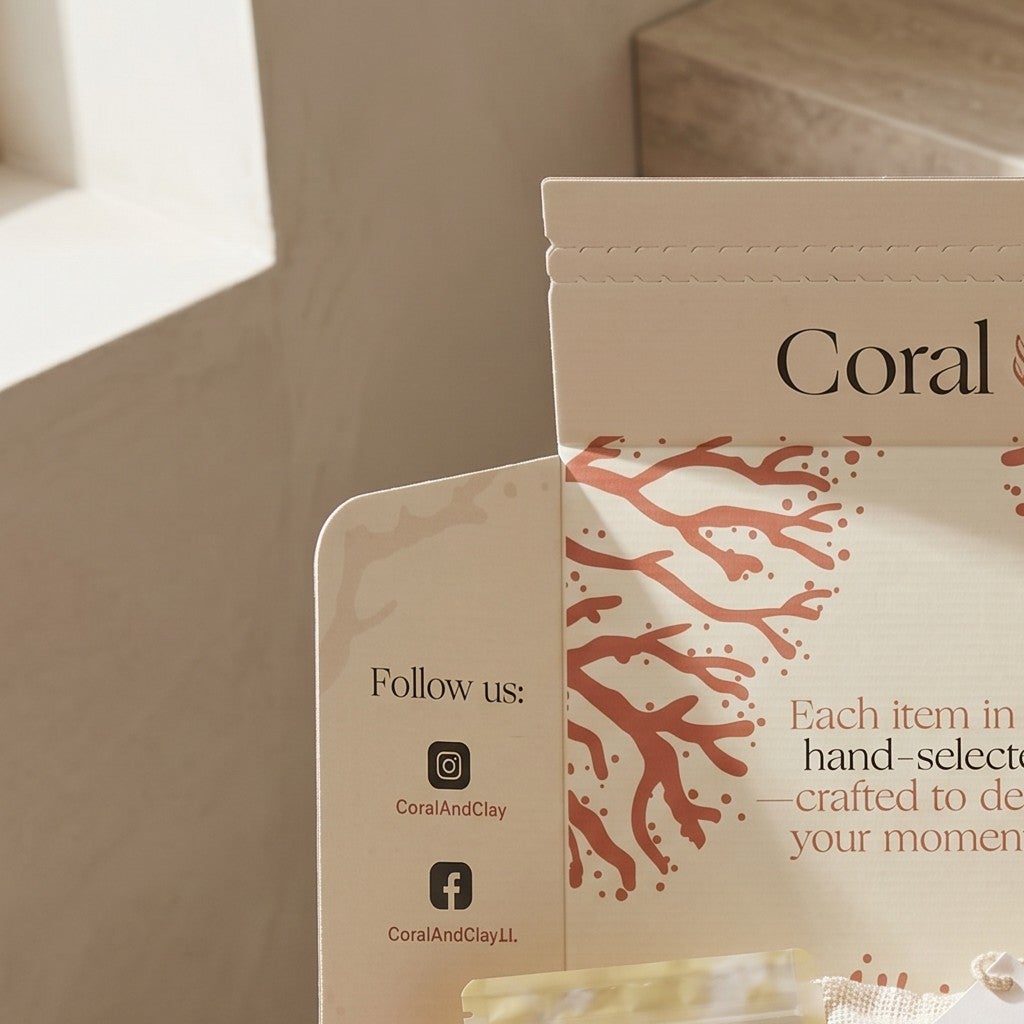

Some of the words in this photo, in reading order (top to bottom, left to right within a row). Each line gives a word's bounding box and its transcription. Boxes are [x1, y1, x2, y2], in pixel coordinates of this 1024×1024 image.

[777, 319, 993, 396] Coral
[371, 666, 474, 701] Follow
[483, 681, 524, 704] us:
[790, 697, 879, 730] Each
[892, 699, 970, 730] item
[983, 699, 1015, 729] in
[395, 798, 507, 821] CoralAndClay
[931, 785, 967, 812] to
[789, 828, 872, 860] your
